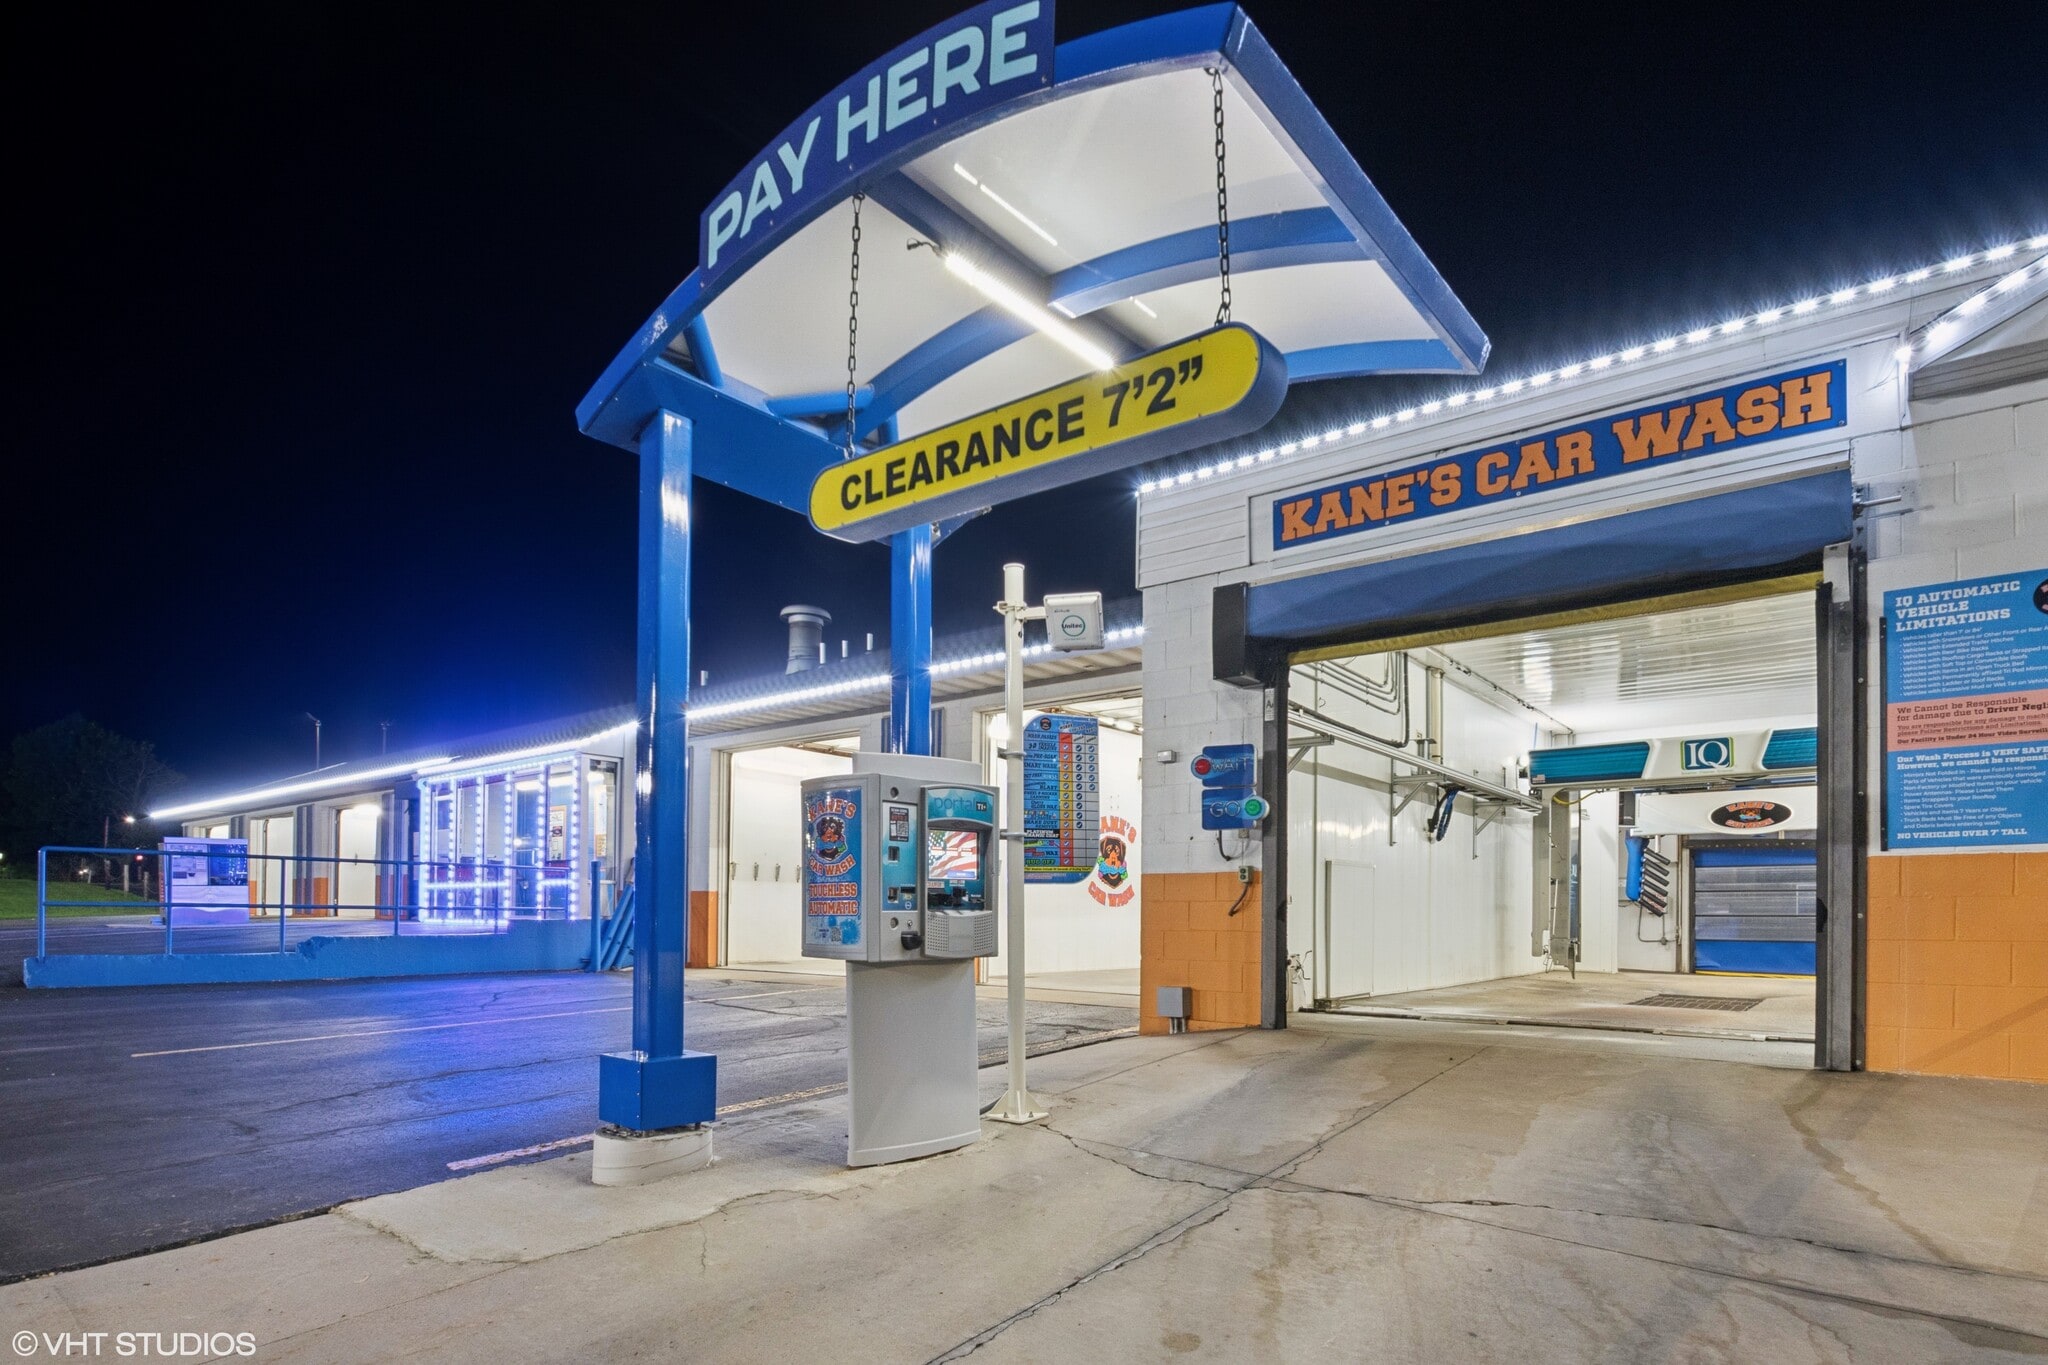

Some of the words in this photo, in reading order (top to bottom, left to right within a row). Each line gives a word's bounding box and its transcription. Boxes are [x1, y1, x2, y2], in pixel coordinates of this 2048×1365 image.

[706, 115, 822, 269] PAY
[836, 0, 1042, 162] HERE
[839, 396, 1085, 511] CLEARANCE
[1102, 355, 1204, 429] 7'2"
[1280, 464, 1462, 543] KANE'S
[1475, 431, 1596, 498] CAR
[1611, 371, 1833, 465] WASH
[1896, 596, 1912, 608] IQ
[1917, 581, 2020, 604] AUTOMATIC
[1896, 601, 1969, 619] VEHICLE
[1896, 608, 2010, 632] LIMITATIONS
[1914, 703, 1948, 712] Cannot
[1966, 696, 2027, 709] Responsible
[1913, 711, 1950, 721] damage
[1954, 709, 1971, 717] due
[1987, 705, 2018, 714] Driver
[1924, 720, 1962, 729] responsible
[1989, 716, 2016, 724] damage
[1911, 736, 1936, 744] Facility
[1687, 740, 1730, 769] IQ
[1943, 751, 1979, 759] Process
[1993, 748, 2019, 756] VERY
[1957, 758, 1989, 766] cannot
[1212, 756, 1250, 770] WAIT
[808, 798, 857, 822] KANE'S
[934, 797, 976, 810] portal
[1210, 800, 1240, 817] GO
[1100, 815, 1137, 844] ANE'S
[809, 856, 824, 874] CAR
[824, 854, 857, 876] WASH
[808, 883, 857, 898] TOUCHLESS
[808, 900, 858, 916] AUTOMATIC
